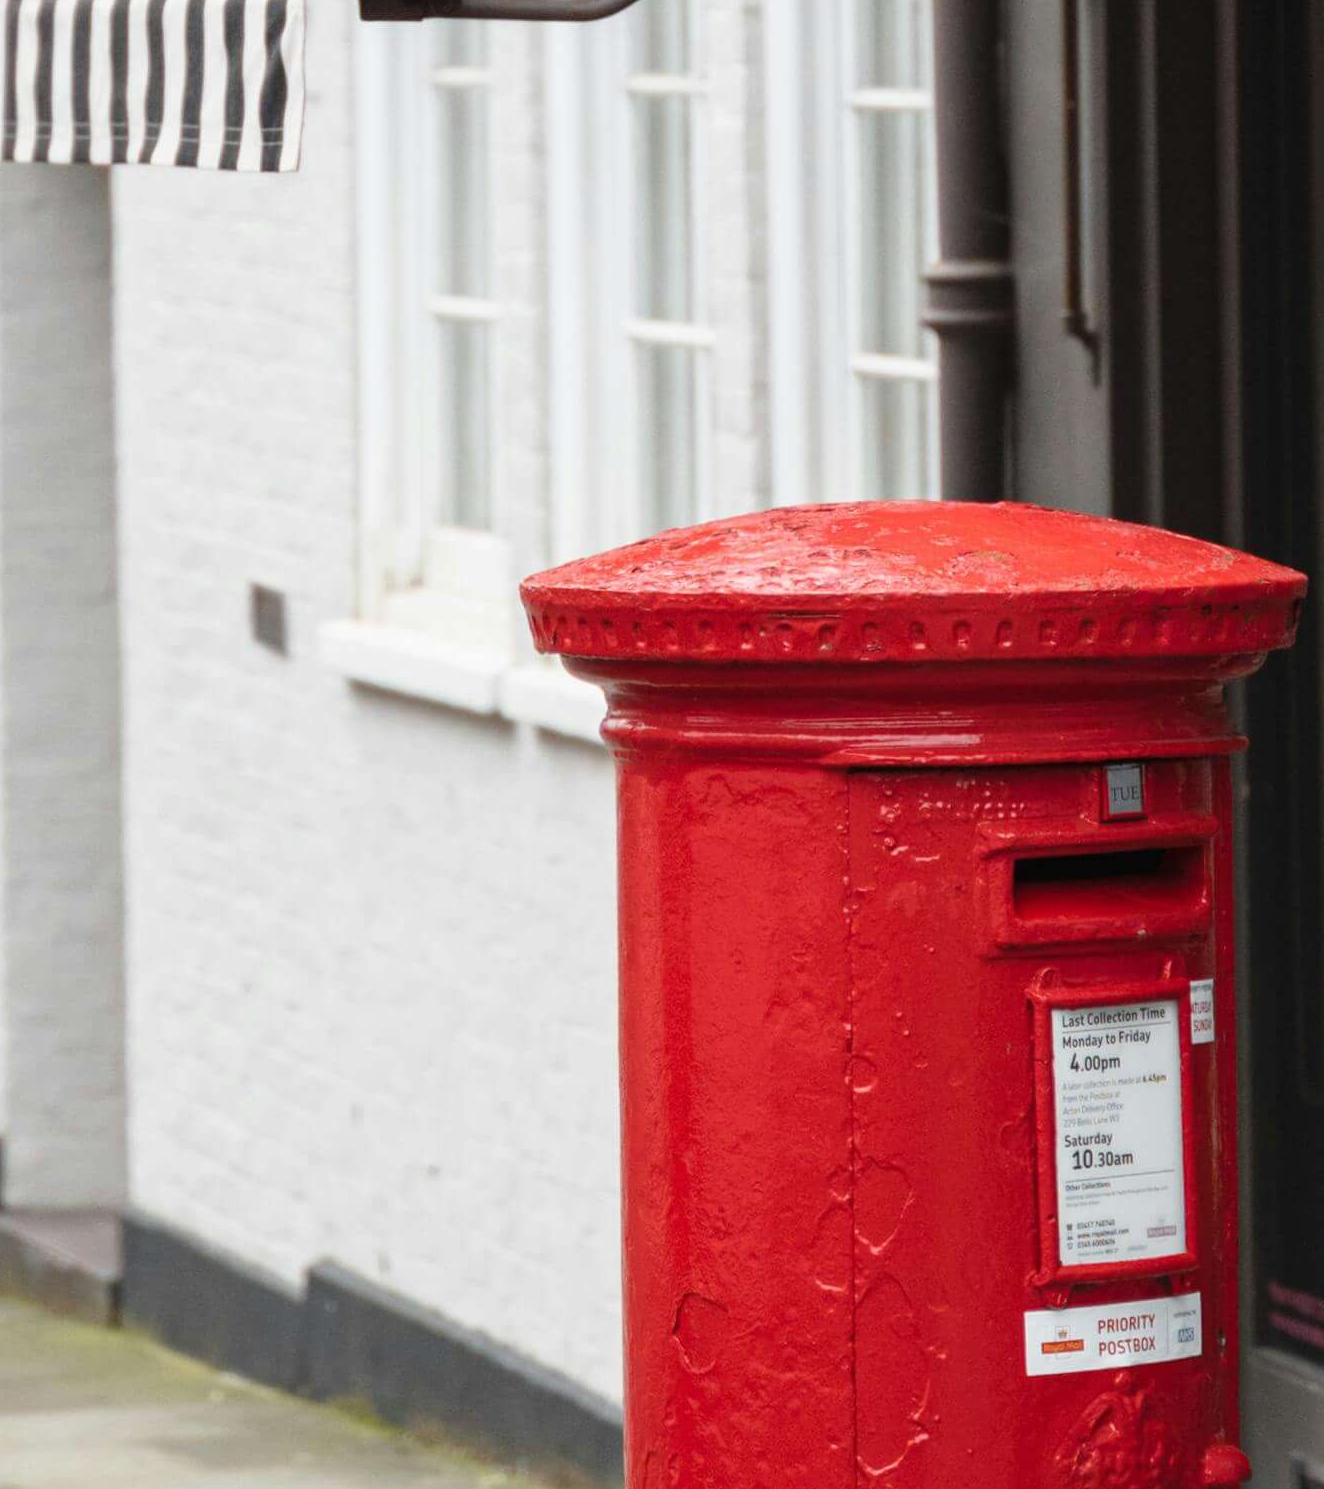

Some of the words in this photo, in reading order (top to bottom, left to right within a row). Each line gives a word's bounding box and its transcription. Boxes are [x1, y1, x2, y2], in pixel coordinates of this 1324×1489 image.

[1111, 785, 1141, 802] TUE
[1062, 1015, 1084, 1028] Last
[1087, 1010, 1138, 1026] Collection
[1140, 1007, 1165, 1020] Time
[1062, 1035, 1103, 1049] Monday
[1106, 1034, 1116, 1044] to
[1119, 1031, 1151, 1045] Friday
[1070, 1053, 1121, 1073] 4.00pm
[1064, 1133, 1113, 1148] Saturday
[1072, 1149, 1134, 1170] 10.30am
[1098, 1314, 1156, 1334] PRIORITY
[1099, 1337, 1156, 1356] POSTBOX
